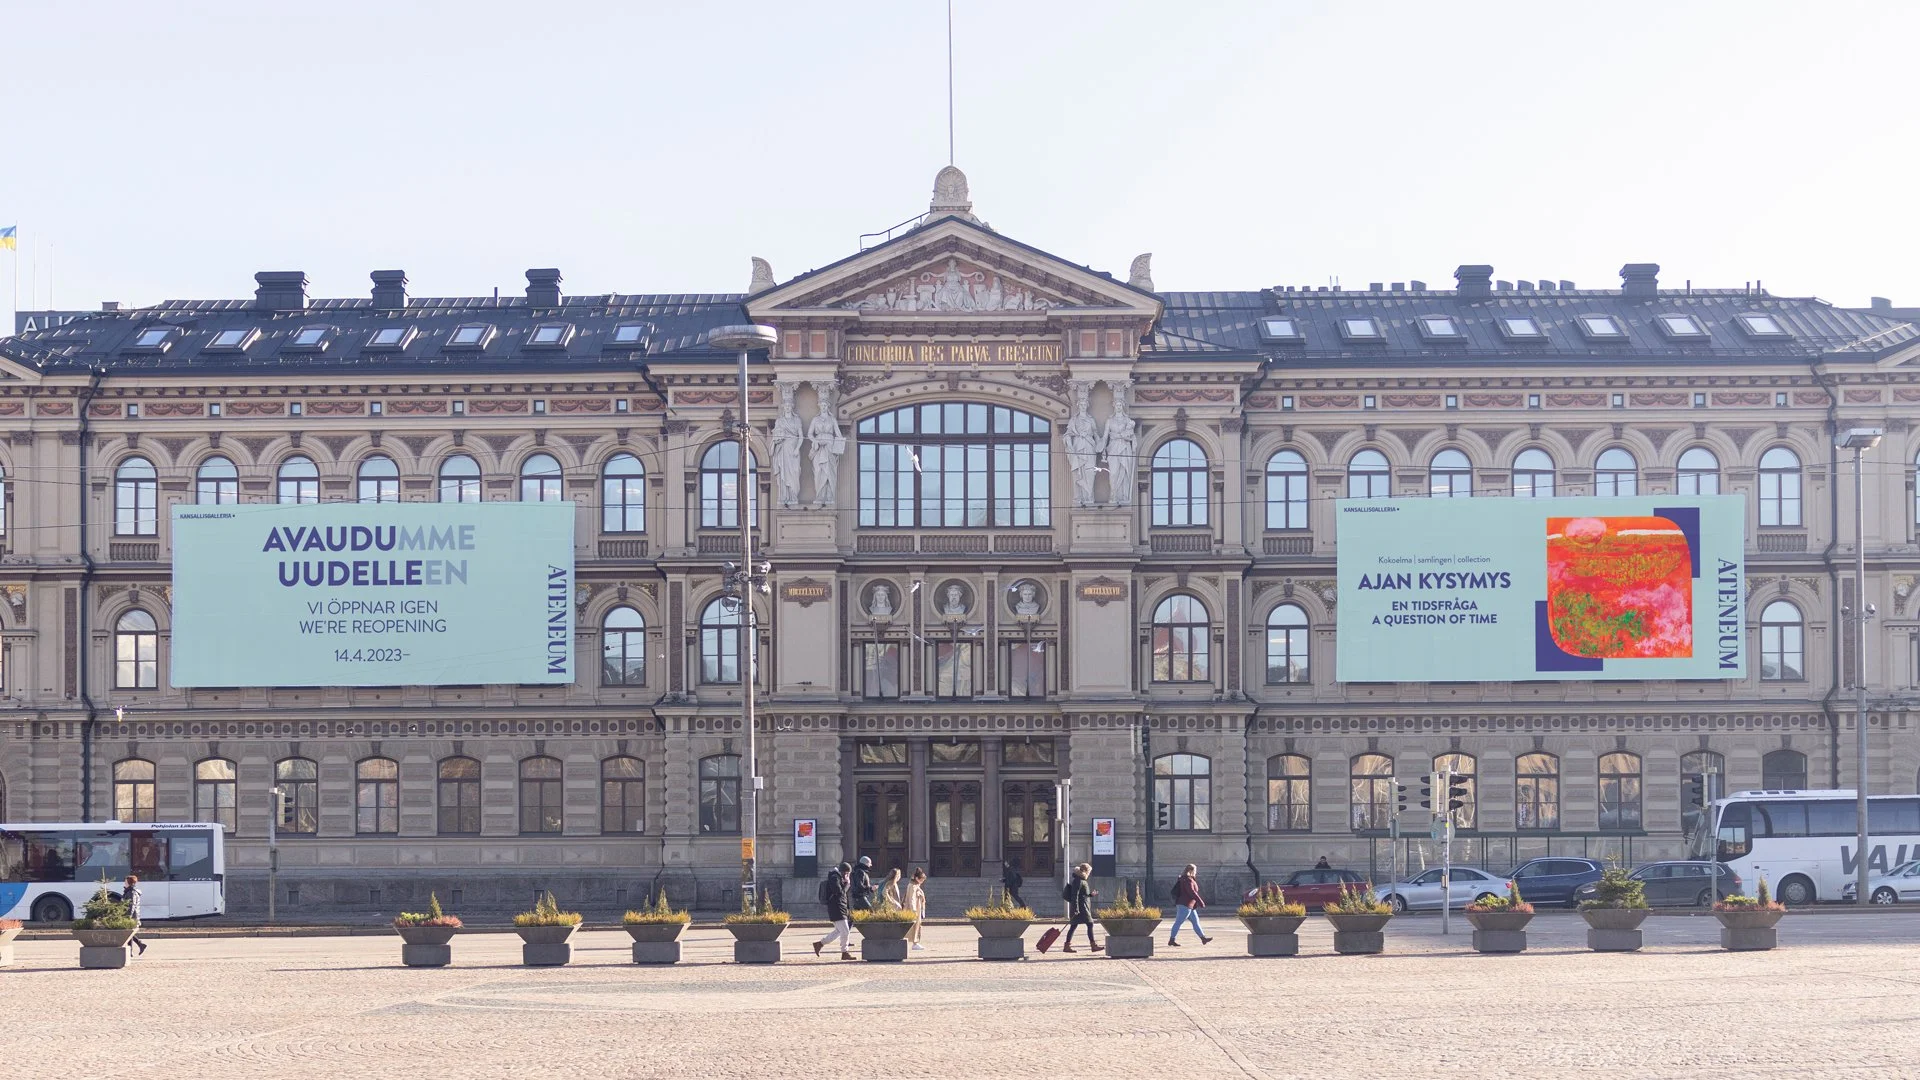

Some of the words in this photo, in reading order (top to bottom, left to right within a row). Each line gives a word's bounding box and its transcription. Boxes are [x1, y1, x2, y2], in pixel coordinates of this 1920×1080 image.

[847, 345, 914, 361] CONCORDIA
[921, 345, 944, 361] RES
[998, 345, 1060, 361] CRESCUNT
[262, 524, 476, 552] AVAUDUMME
[1378, 556, 1412, 564] Kokoelma
[1417, 555, 1452, 566] samlingen
[1457, 555, 1491, 563] collection
[278, 559, 468, 587] UUDELLEEN
[1357, 573, 1412, 590] AJAN
[1419, 572, 1512, 589] KYSYMYS
[307, 601, 323, 615] VI
[328, 598, 395, 615] ÖPPNAR
[400, 600, 438, 614] IGEN
[1392, 601, 1408, 611] EN
[1411, 597, 1478, 611] TIDSFRÅGA
[547, 564, 567, 674] ATENEUM
[1372, 615, 1381, 625] A
[1383, 614, 1446, 627] QUESTION
[1449, 614, 1466, 625] OF
[1469, 613, 1498, 624] TIME
[1718, 558, 1738, 669] ATENEUM
[299, 620, 347, 634] WE'RE
[352, 619, 447, 634] REOPENING
